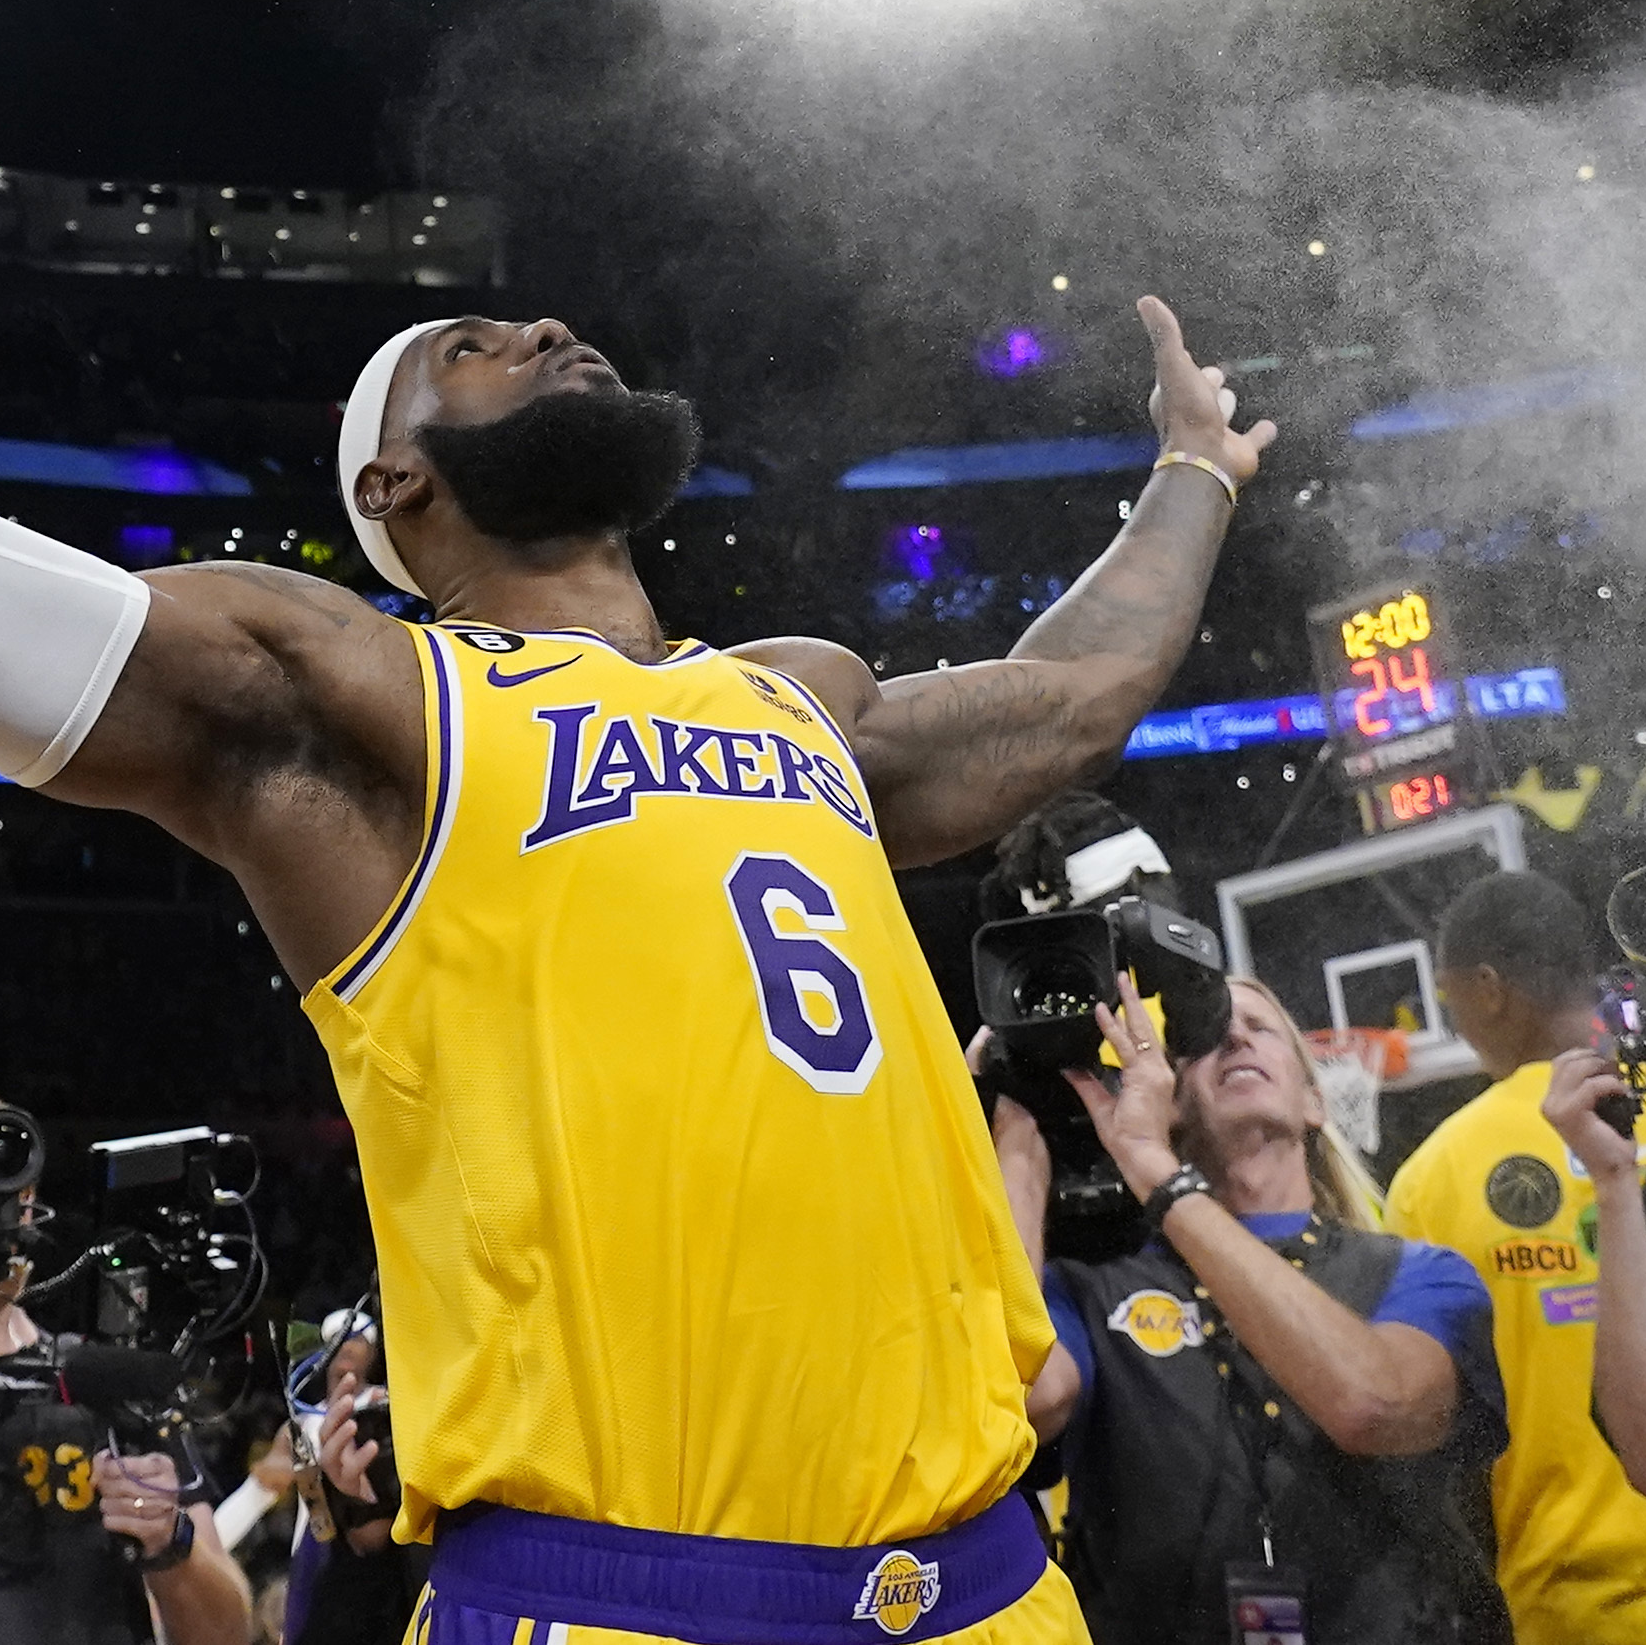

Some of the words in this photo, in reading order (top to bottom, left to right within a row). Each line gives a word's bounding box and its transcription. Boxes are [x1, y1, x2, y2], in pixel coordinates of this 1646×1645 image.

[1342, 593, 1431, 659] 12:00
[1351, 649, 1435, 736] 24
[521, 701, 875, 854] LAKERS
[722, 851, 884, 1095] 6
[1496, 1247, 1576, 1272] HBCU
[864, 1575, 936, 1615] LAKERS
